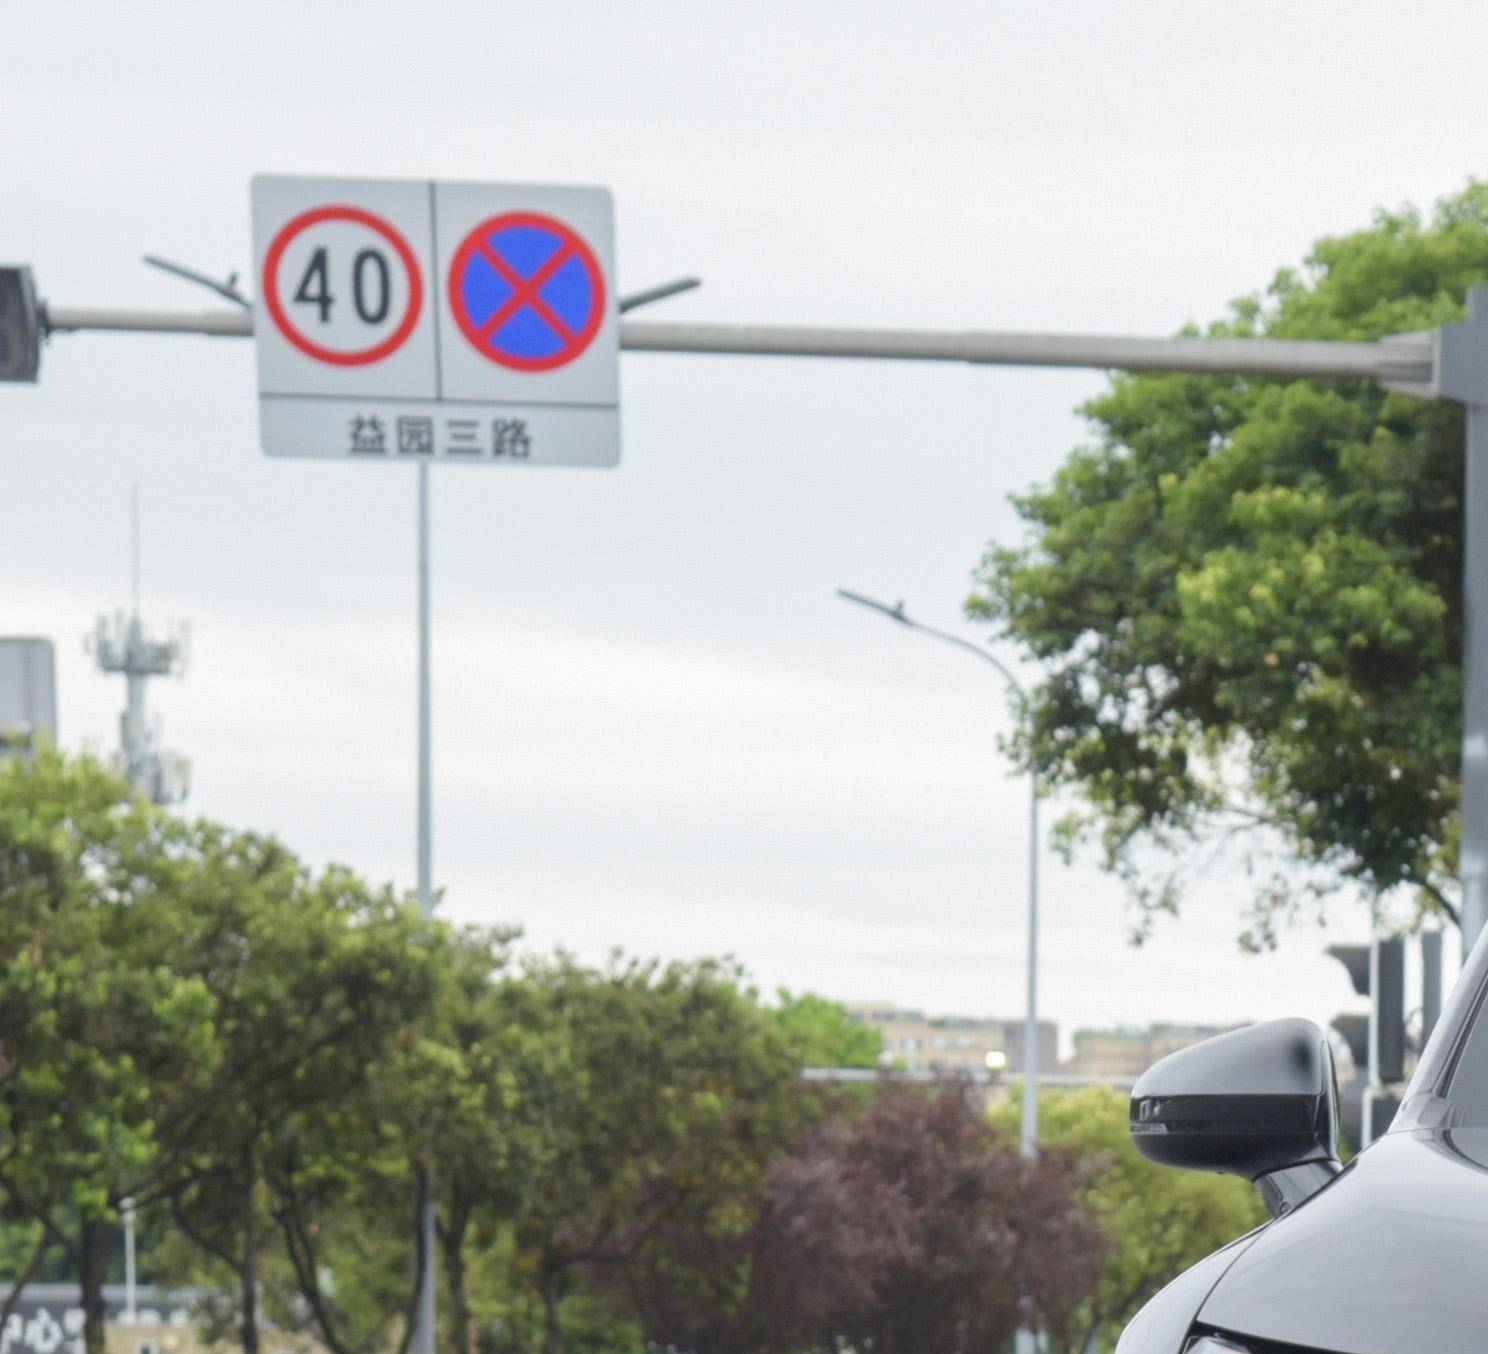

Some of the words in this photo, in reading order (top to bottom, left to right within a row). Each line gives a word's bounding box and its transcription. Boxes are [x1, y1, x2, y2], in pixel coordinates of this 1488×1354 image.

[294, 248, 390, 325] 40
[348, 414, 532, 458] 益园三路
